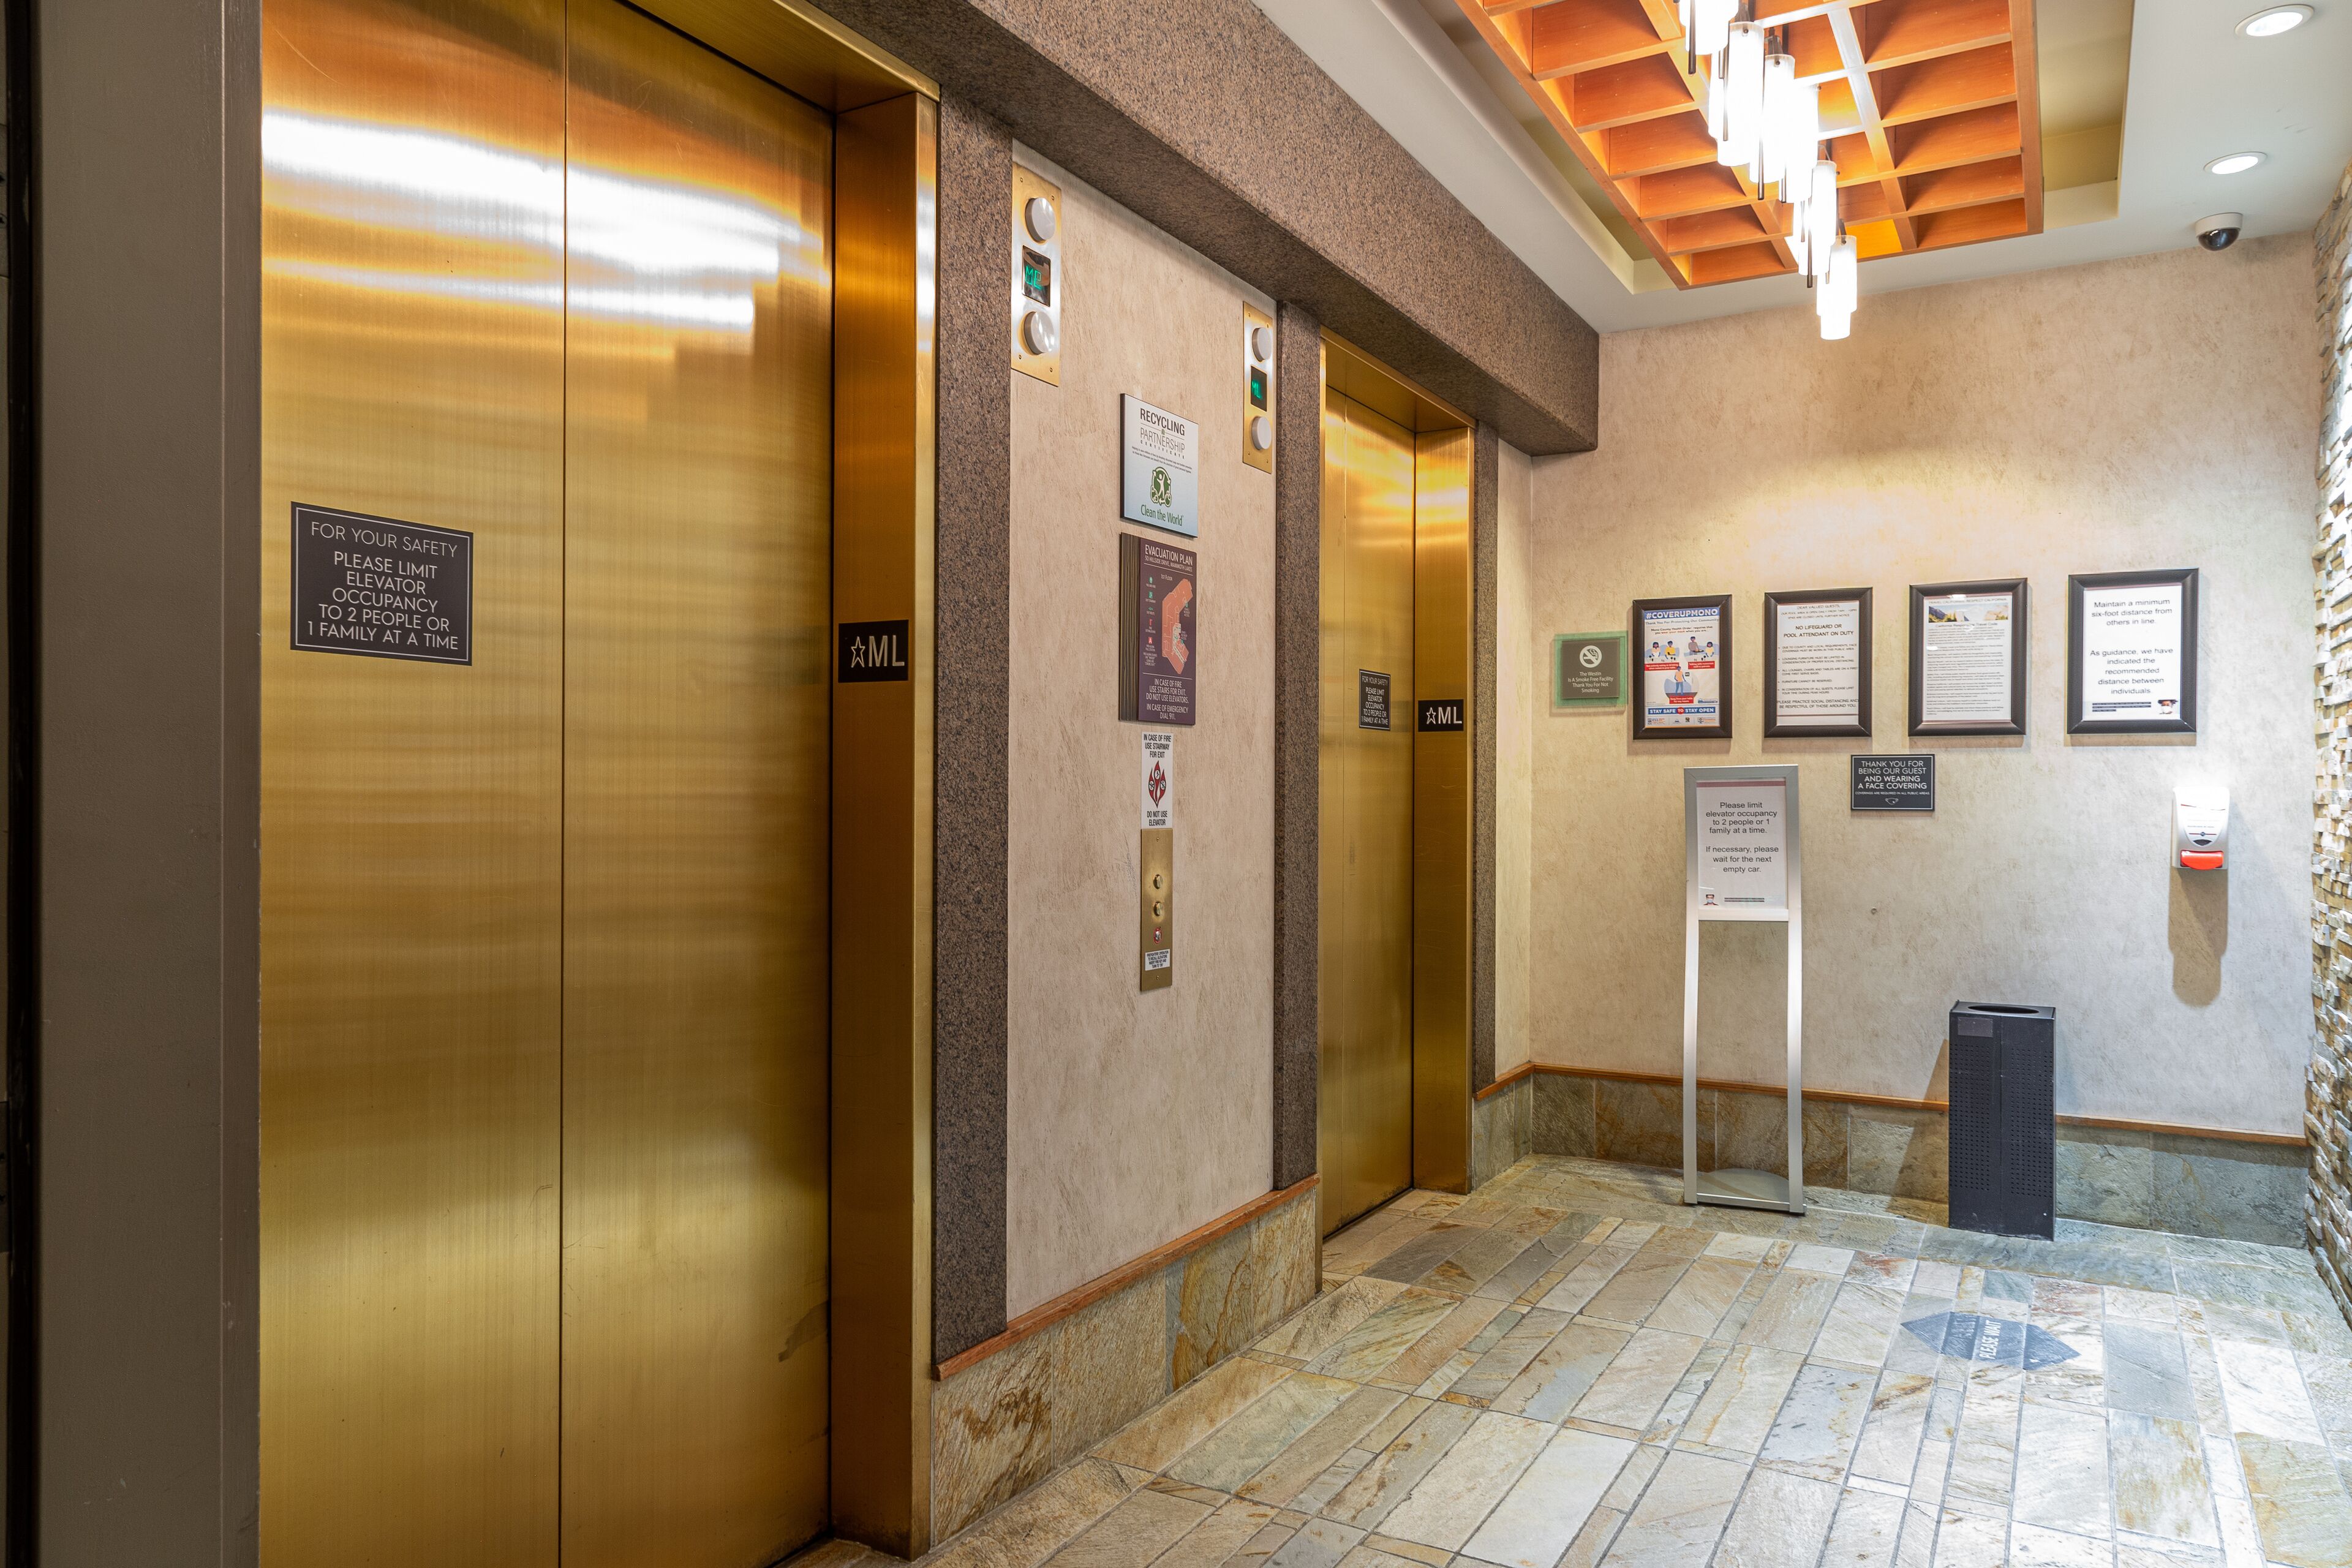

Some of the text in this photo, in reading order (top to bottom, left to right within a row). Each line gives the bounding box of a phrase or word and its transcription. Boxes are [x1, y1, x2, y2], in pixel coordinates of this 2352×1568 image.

[1140, 408, 1185, 435] RECYCLING
[1140, 428, 1185, 454] PARTNERSHIP
[1141, 505, 1156, 518] Clean
[312, 522, 457, 557] FOR YOUR SAFETY
[335, 551, 437, 578] PLEASE LIMIT
[1145, 545, 1192, 565] EVACUATION PLAN
[347, 571, 425, 594] ELEVATOR
[333, 588, 437, 612] OCCUPANCY
[319, 604, 449, 631] TO 2 PEOPLE OR
[1646, 609, 1717, 619] #COVERUPMONO
[308, 622, 458, 649] 1 FAMILY AT A TIME
[869, 635, 905, 666] ML
[2102, 649, 2138, 658] guidance,
[1438, 707, 1462, 724] ML
[1979, 1320, 2001, 1359] PLEASE WAIT
